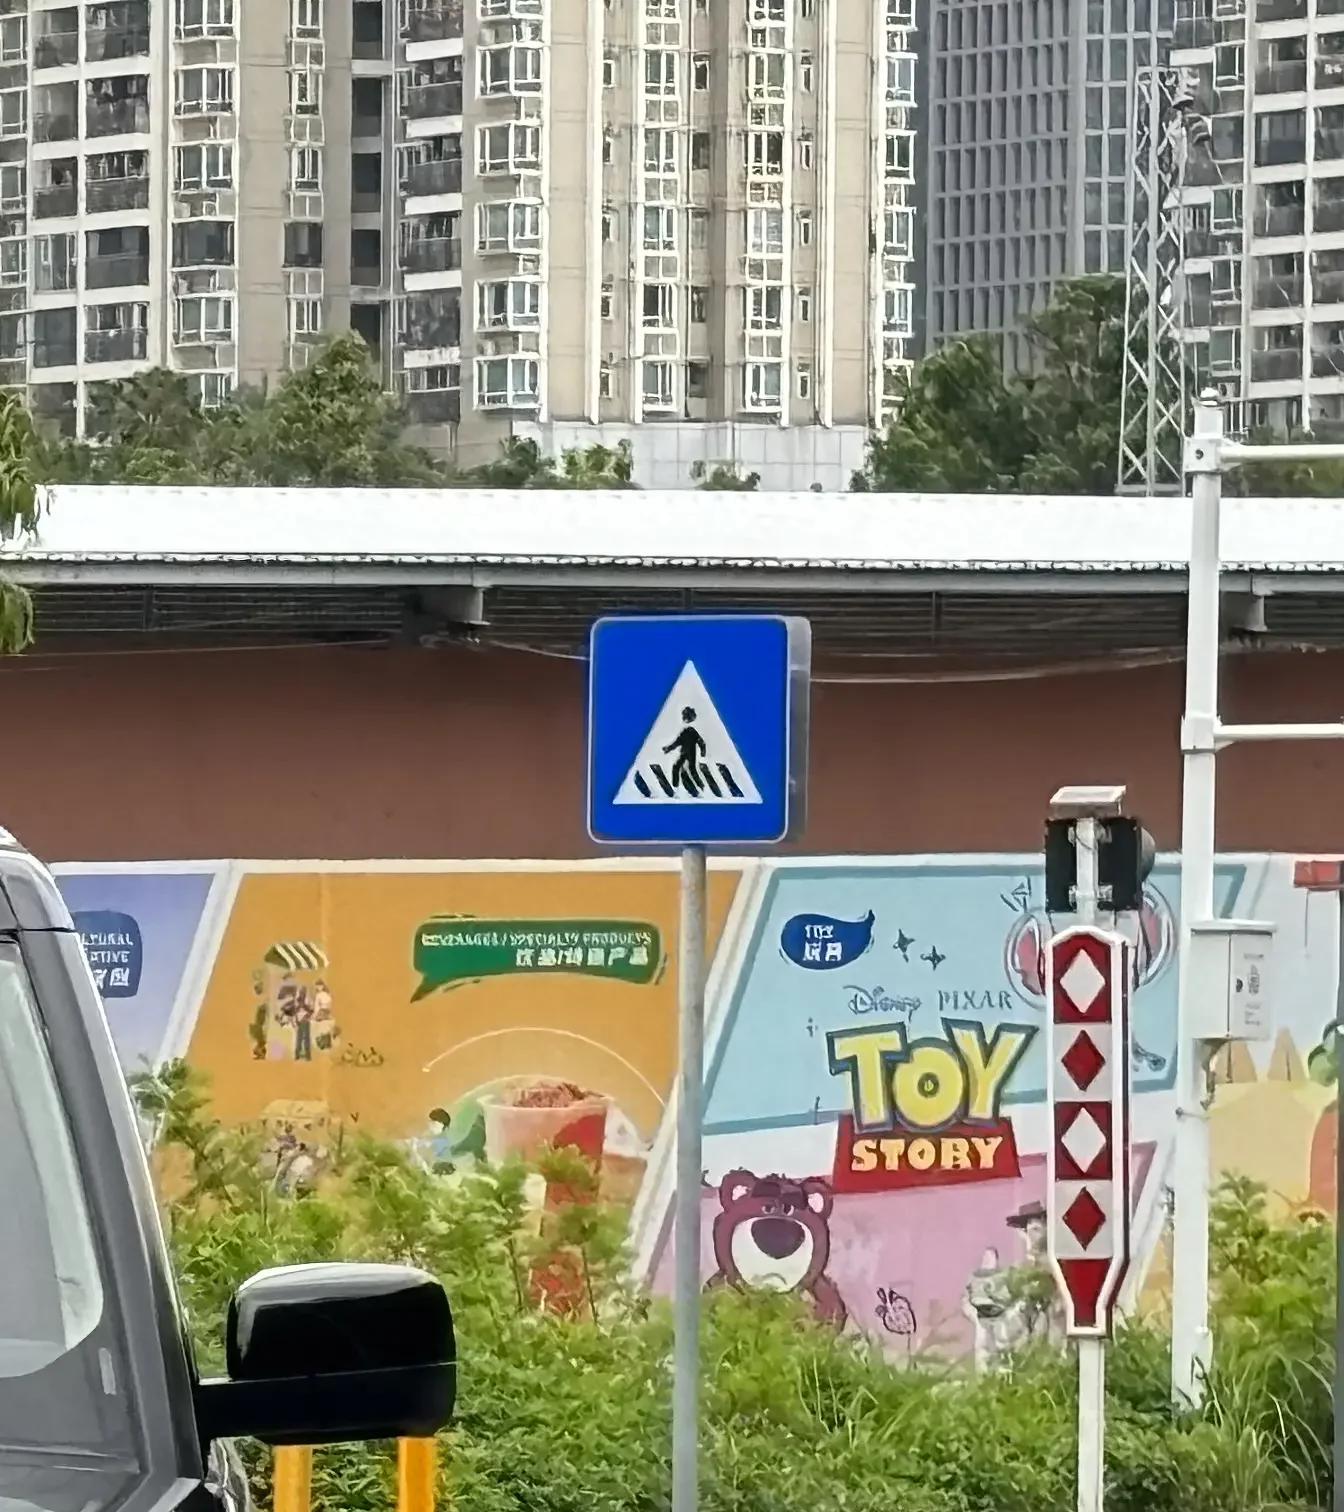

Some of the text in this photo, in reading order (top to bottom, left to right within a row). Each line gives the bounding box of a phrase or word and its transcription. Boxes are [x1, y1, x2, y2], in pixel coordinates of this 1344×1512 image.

[938, 989, 1014, 1012] PIXAR
[826, 1017, 1040, 1134] TOY
[851, 1136, 1004, 1172] STORY
